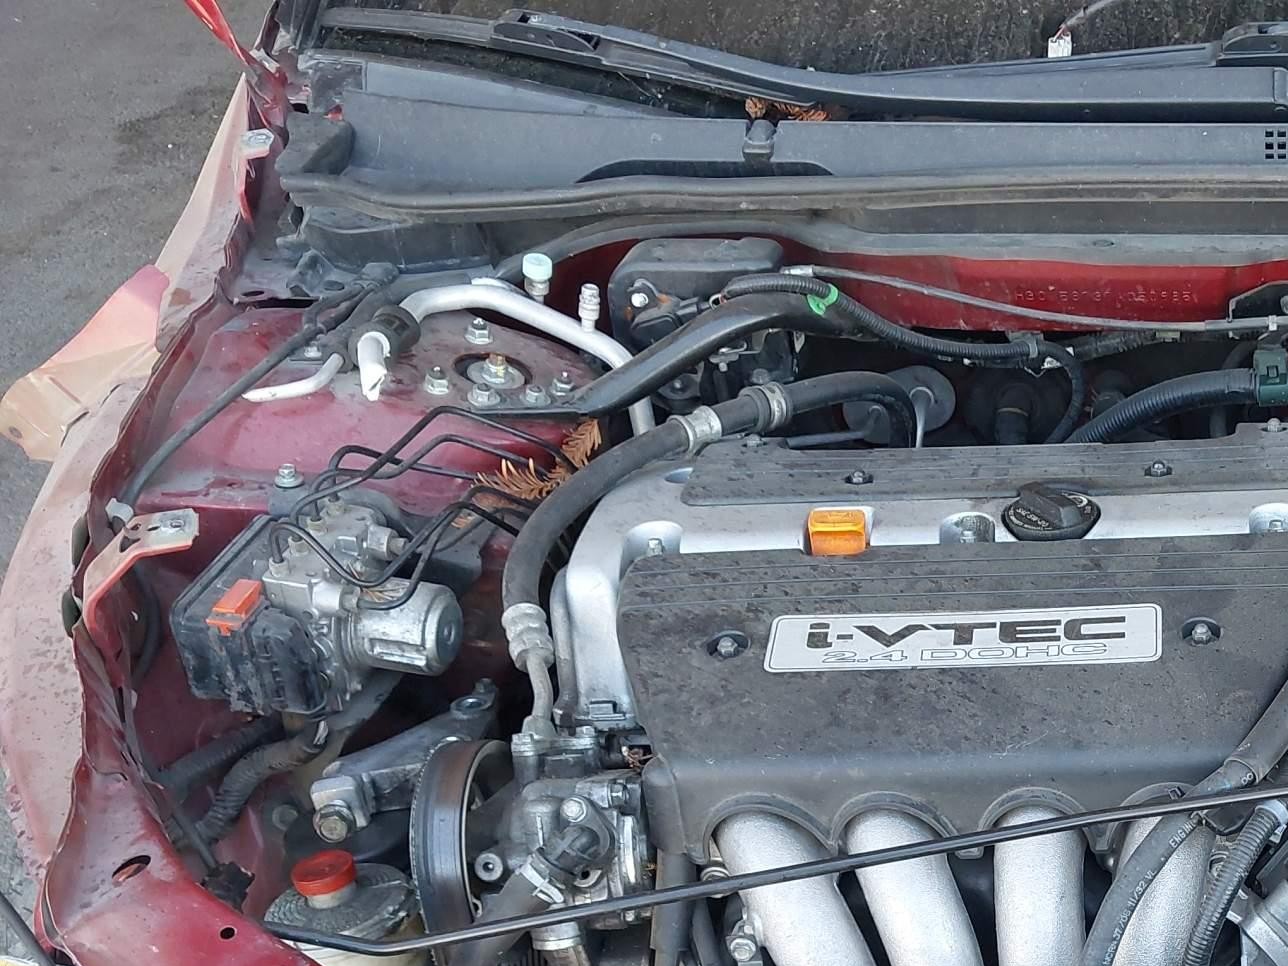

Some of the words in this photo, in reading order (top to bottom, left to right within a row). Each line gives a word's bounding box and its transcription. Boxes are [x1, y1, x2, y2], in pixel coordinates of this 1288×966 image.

[806, 616, 1126, 649] i-VTEC
[822, 649, 907, 663] 2.4
[920, 642, 1108, 662] DOHC
